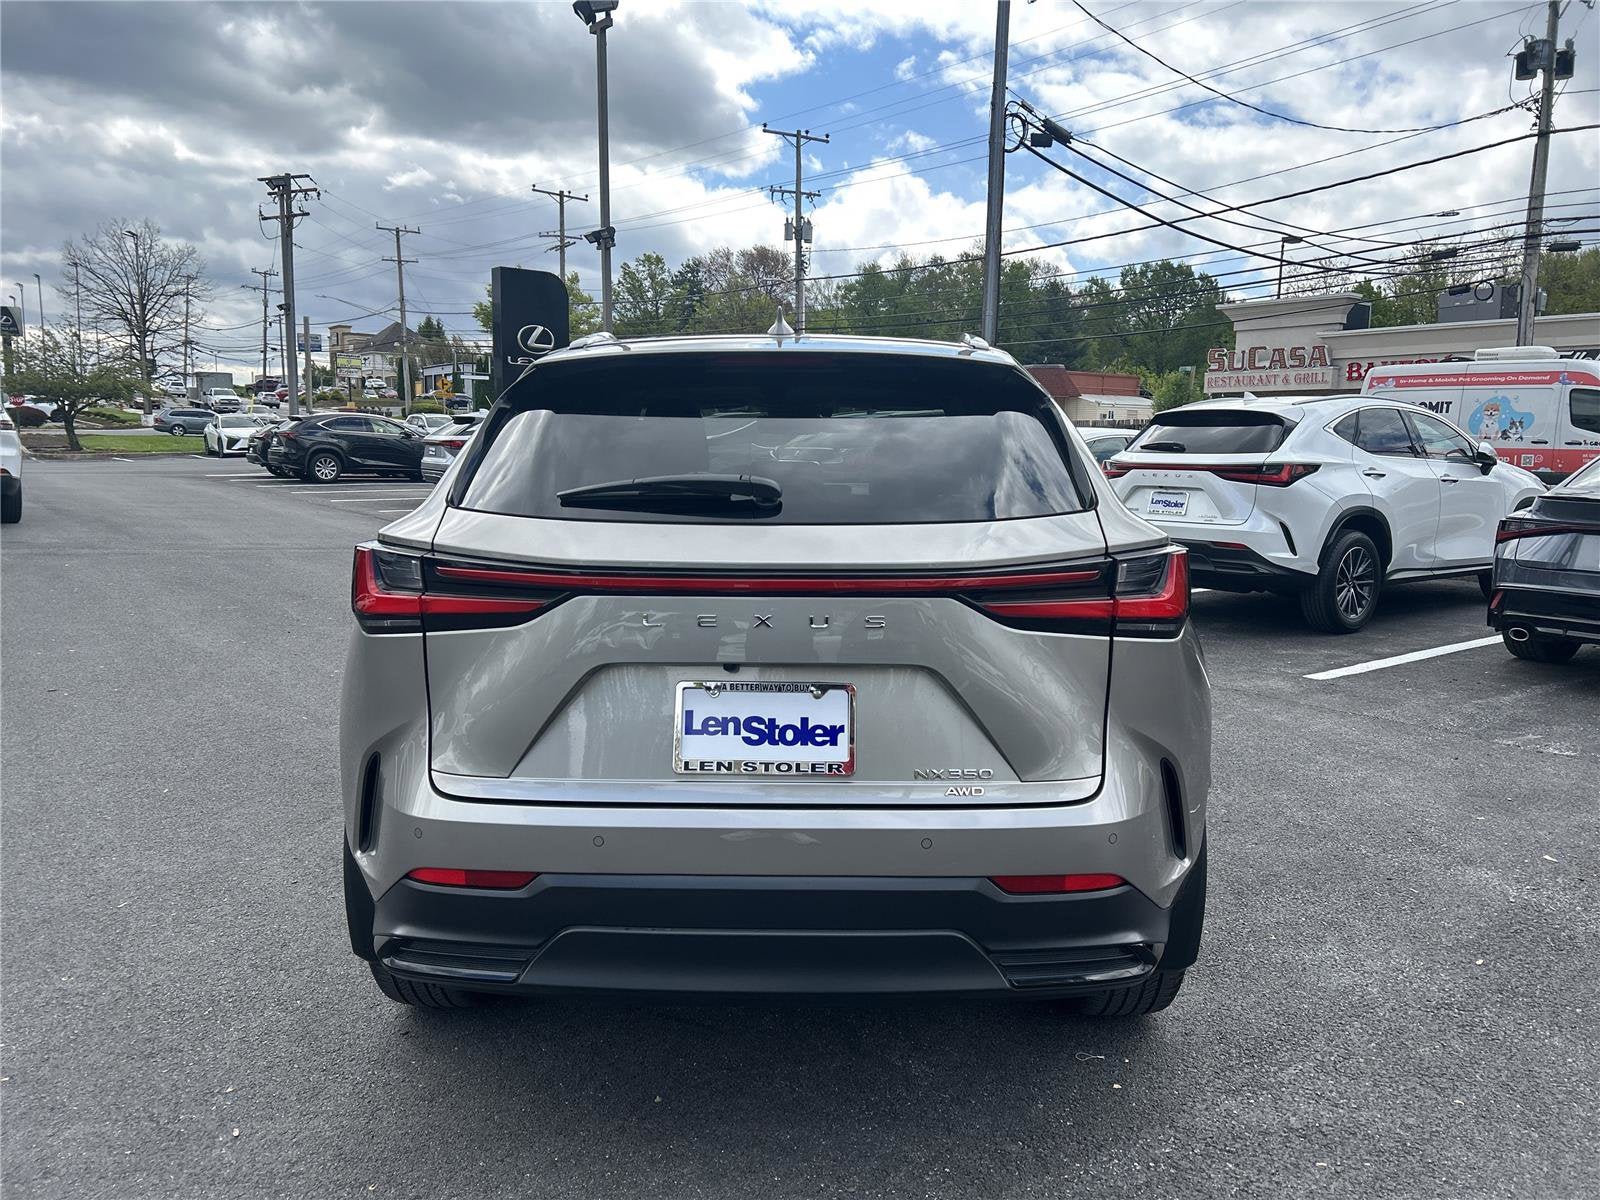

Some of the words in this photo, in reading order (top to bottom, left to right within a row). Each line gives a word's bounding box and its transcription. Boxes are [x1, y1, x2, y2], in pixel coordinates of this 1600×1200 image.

[1207, 374, 1279, 388] RESTAURANT
[1281, 373, 1291, 385] &
[1294, 371, 1329, 384] GRILL
[642, 613, 887, 629] LEXUS
[730, 683, 760, 691] BETTER
[762, 683, 779, 692] WAY
[780, 684, 792, 692] TO
[794, 684, 810, 692] BUY
[683, 761, 733, 772] LEN
[742, 762, 845, 775] STOLER
[945, 786, 985, 796] AWD
